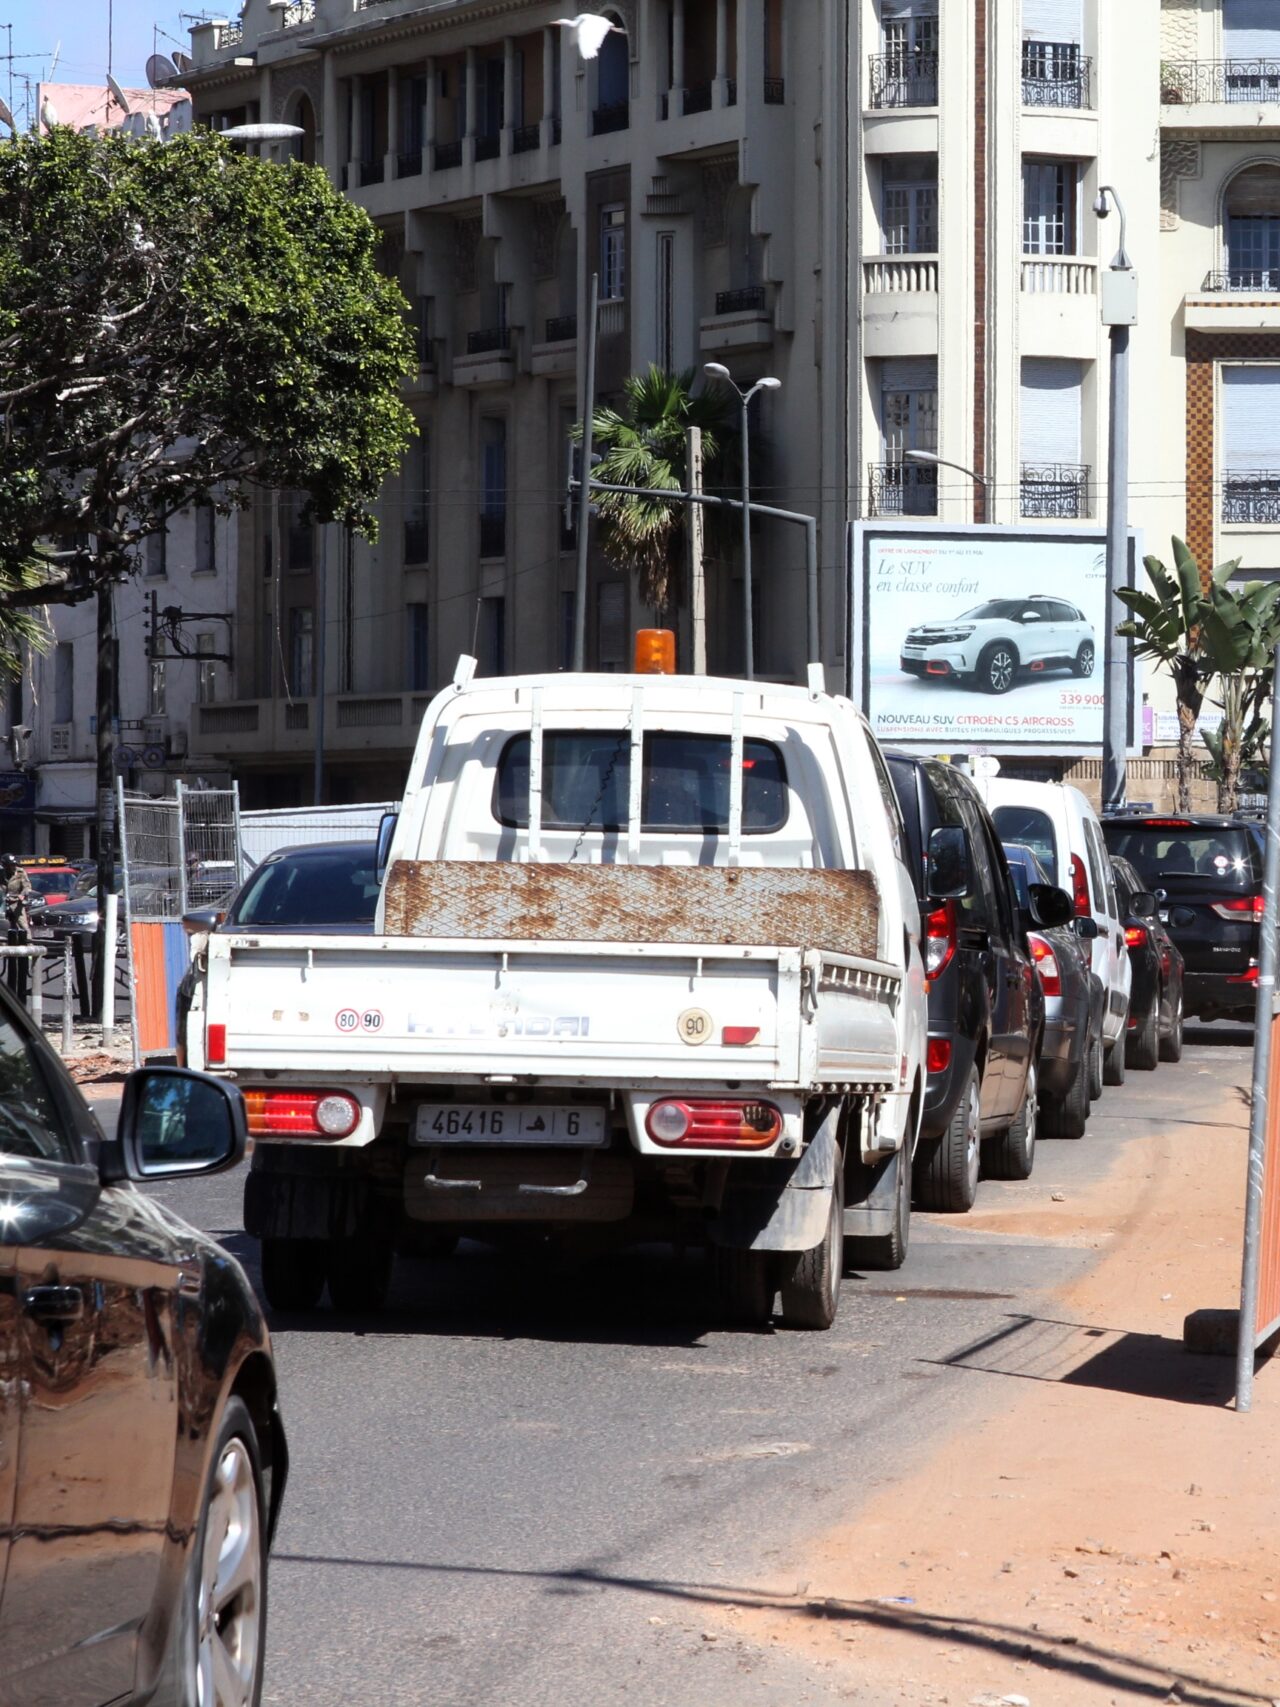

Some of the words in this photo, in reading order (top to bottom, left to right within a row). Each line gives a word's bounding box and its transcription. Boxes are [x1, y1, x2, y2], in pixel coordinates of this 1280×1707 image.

[877, 559, 895, 575] Le
[899, 561, 932, 575] SUV
[876, 581, 892, 592] en
[896, 577, 932, 593] classe
[936, 577, 980, 598] confort
[1060, 694, 1082, 705] 339
[877, 714, 931, 725] NOUVEAU
[933, 714, 954, 725] SUV
[1005, 716, 1019, 726] C5
[1021, 716, 1074, 727] AIRCROSS
[340, 1014, 355, 1027] 80
[364, 1014, 381, 1028] 90
[686, 1016, 705, 1035] 90
[432, 1110, 503, 1135] 46416
[567, 1112, 580, 1136] 6
